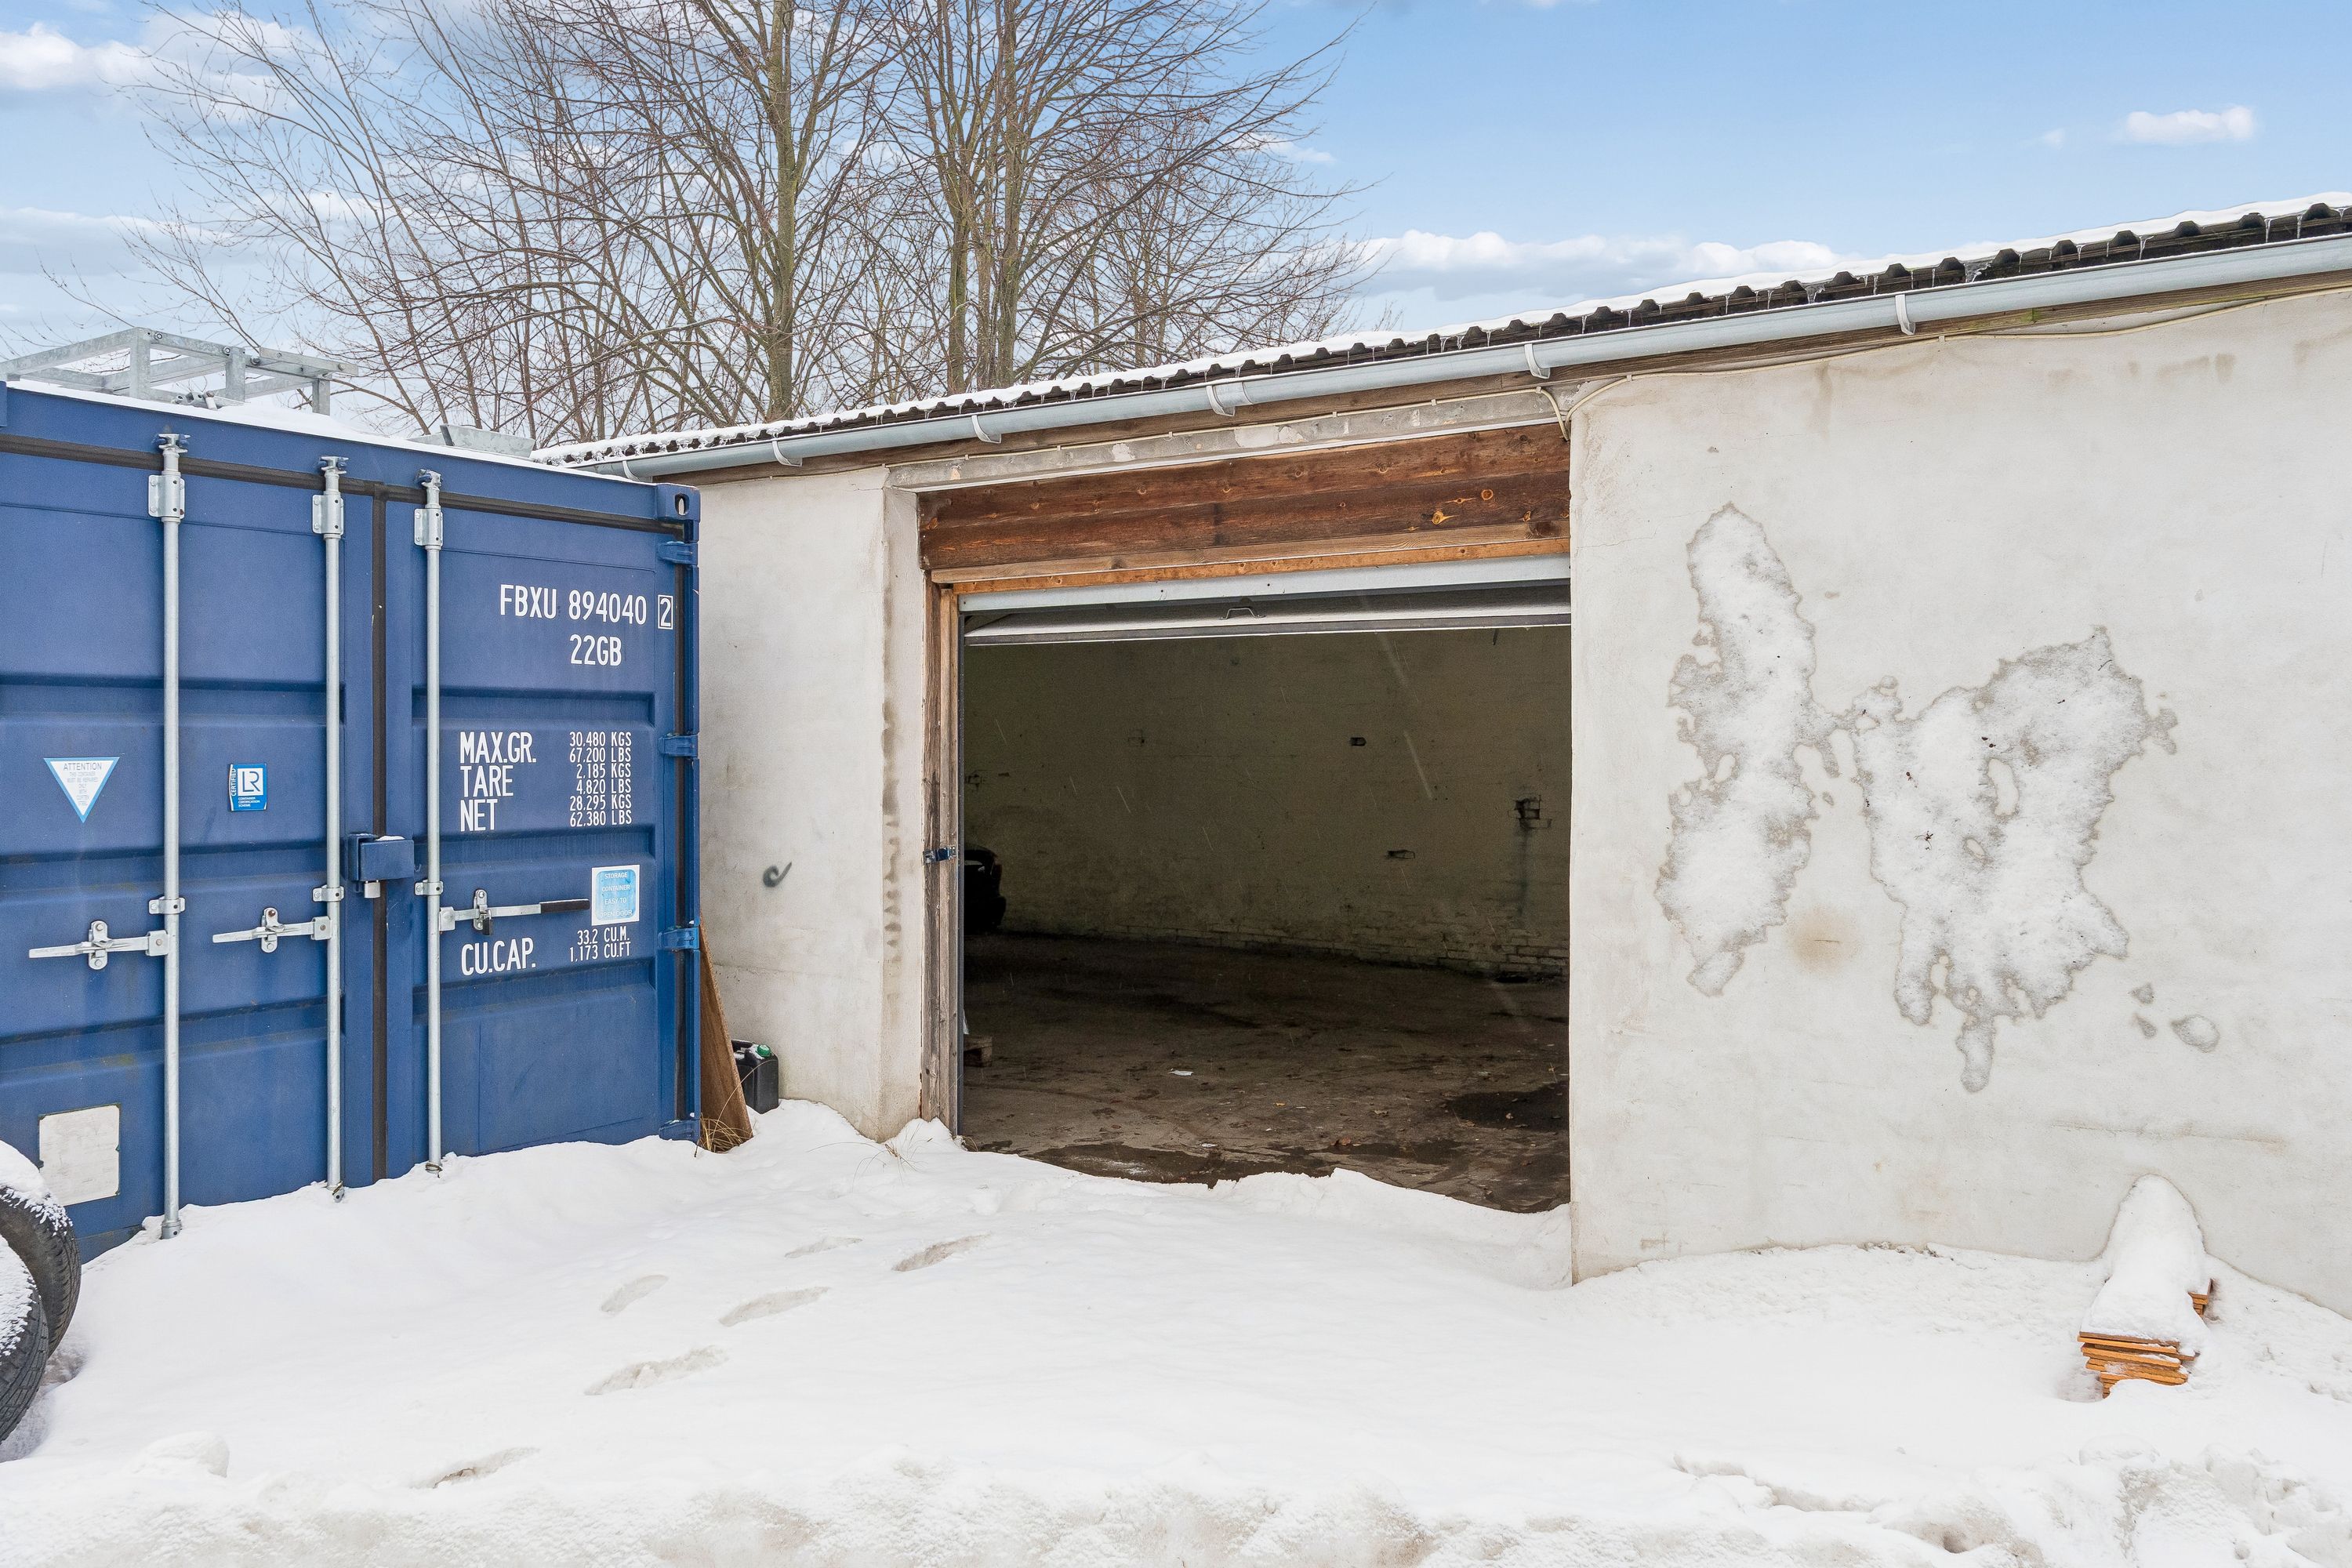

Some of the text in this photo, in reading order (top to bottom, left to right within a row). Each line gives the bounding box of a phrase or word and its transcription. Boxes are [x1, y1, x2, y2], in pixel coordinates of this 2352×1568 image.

[500, 584, 673, 627] FBXU 894040 2
[569, 633, 622, 666] 22GB
[459, 731, 536, 764] MAX.GR.
[569, 731, 632, 746] 30,480 KGS
[569, 748, 632, 763] 67,200 LBS
[64, 762, 102, 771] ATTENTION
[576, 764, 632, 779] 2,185 KGS
[242, 771, 261, 792] LR
[459, 765, 514, 798] TARE
[576, 779, 632, 795] 4,820 LBS
[569, 794, 633, 811] 28,295 KGS
[459, 799, 499, 832] NET
[569, 810, 633, 828] 62,380 LBS
[577, 926, 630, 945] 33.2 CU.M.
[460, 937, 536, 976] CU.CAP.
[569, 941, 631, 963] 1,173 CU.FT
